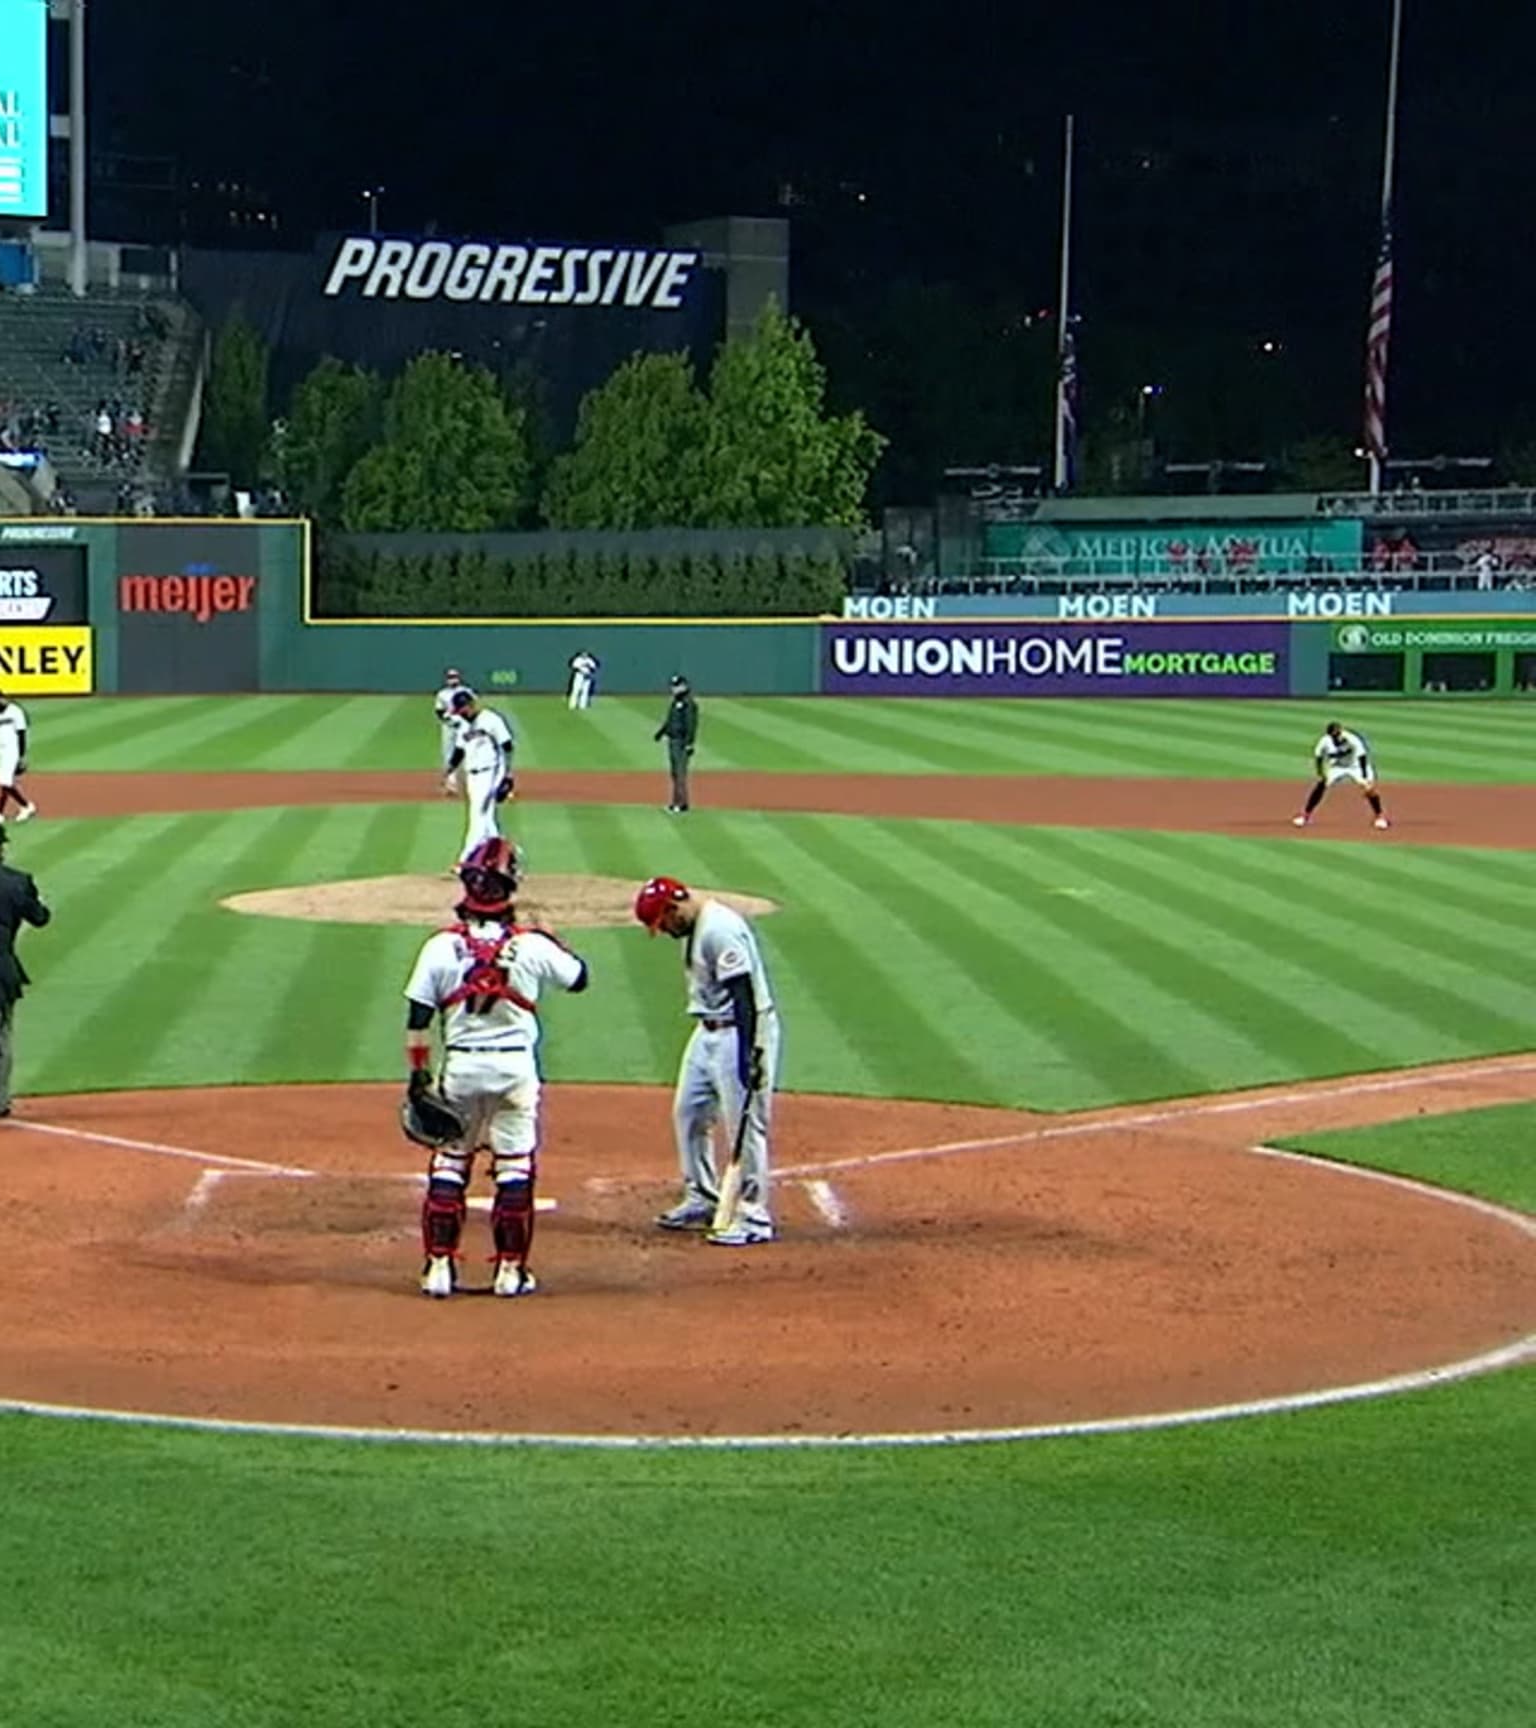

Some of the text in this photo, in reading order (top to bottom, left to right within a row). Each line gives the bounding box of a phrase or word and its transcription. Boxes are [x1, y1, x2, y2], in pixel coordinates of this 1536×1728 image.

[325, 238, 697, 307] PROGRESSIVE
[121, 563, 255, 622] meijer
[843, 596, 937, 618] MOEN
[1059, 595, 1156, 618] MOEN
[1287, 592, 1393, 617] MOEN
[1371, 631, 1403, 645] OLD
[1124, 653, 1276, 675] MORTGAGE
